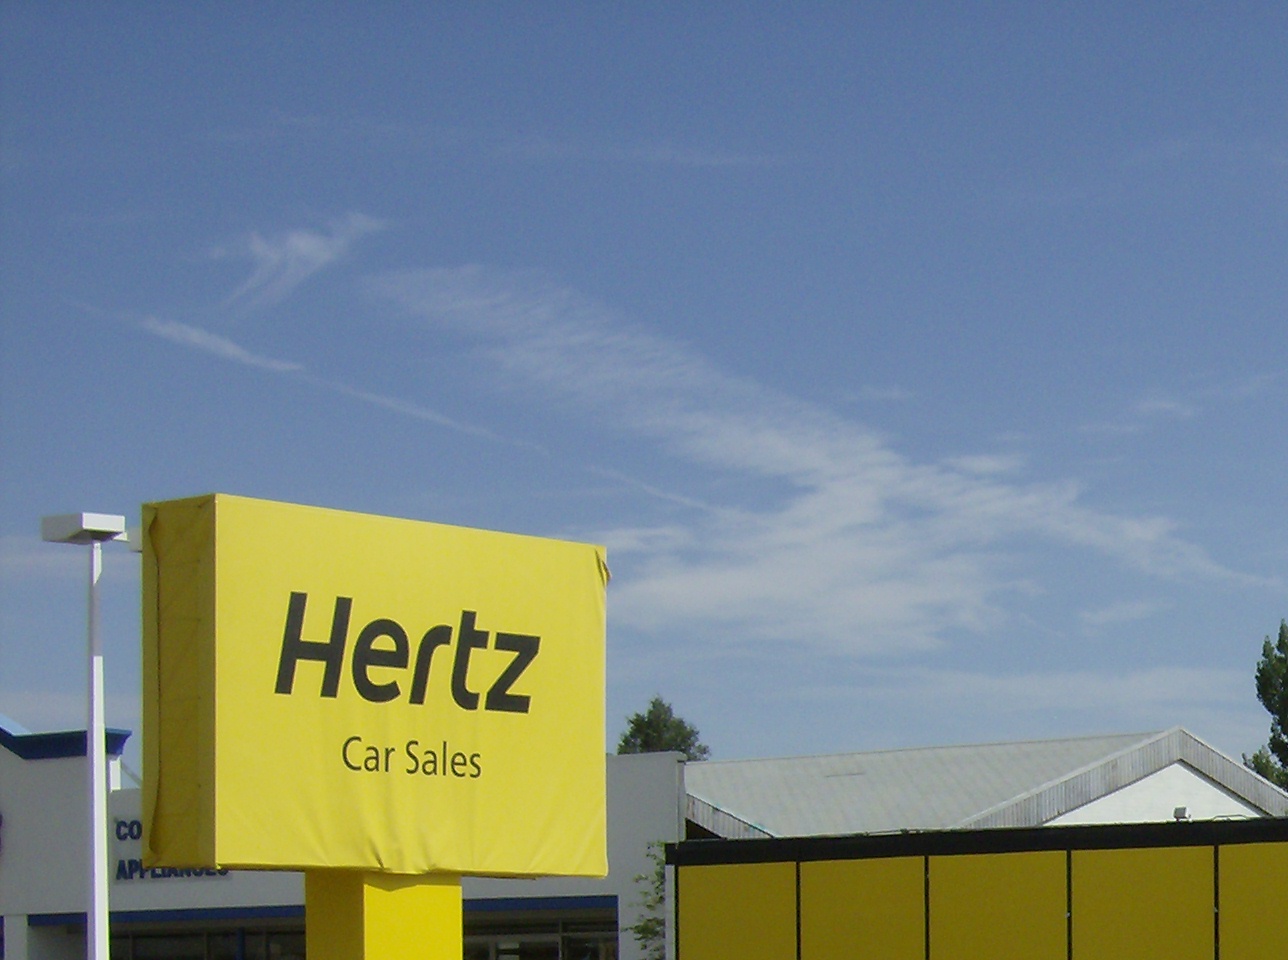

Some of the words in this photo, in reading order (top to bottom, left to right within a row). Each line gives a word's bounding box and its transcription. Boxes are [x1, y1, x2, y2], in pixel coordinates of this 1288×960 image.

[274, 591, 541, 714] Hertz
[342, 736, 396, 773] Car
[405, 739, 482, 778] Sales
